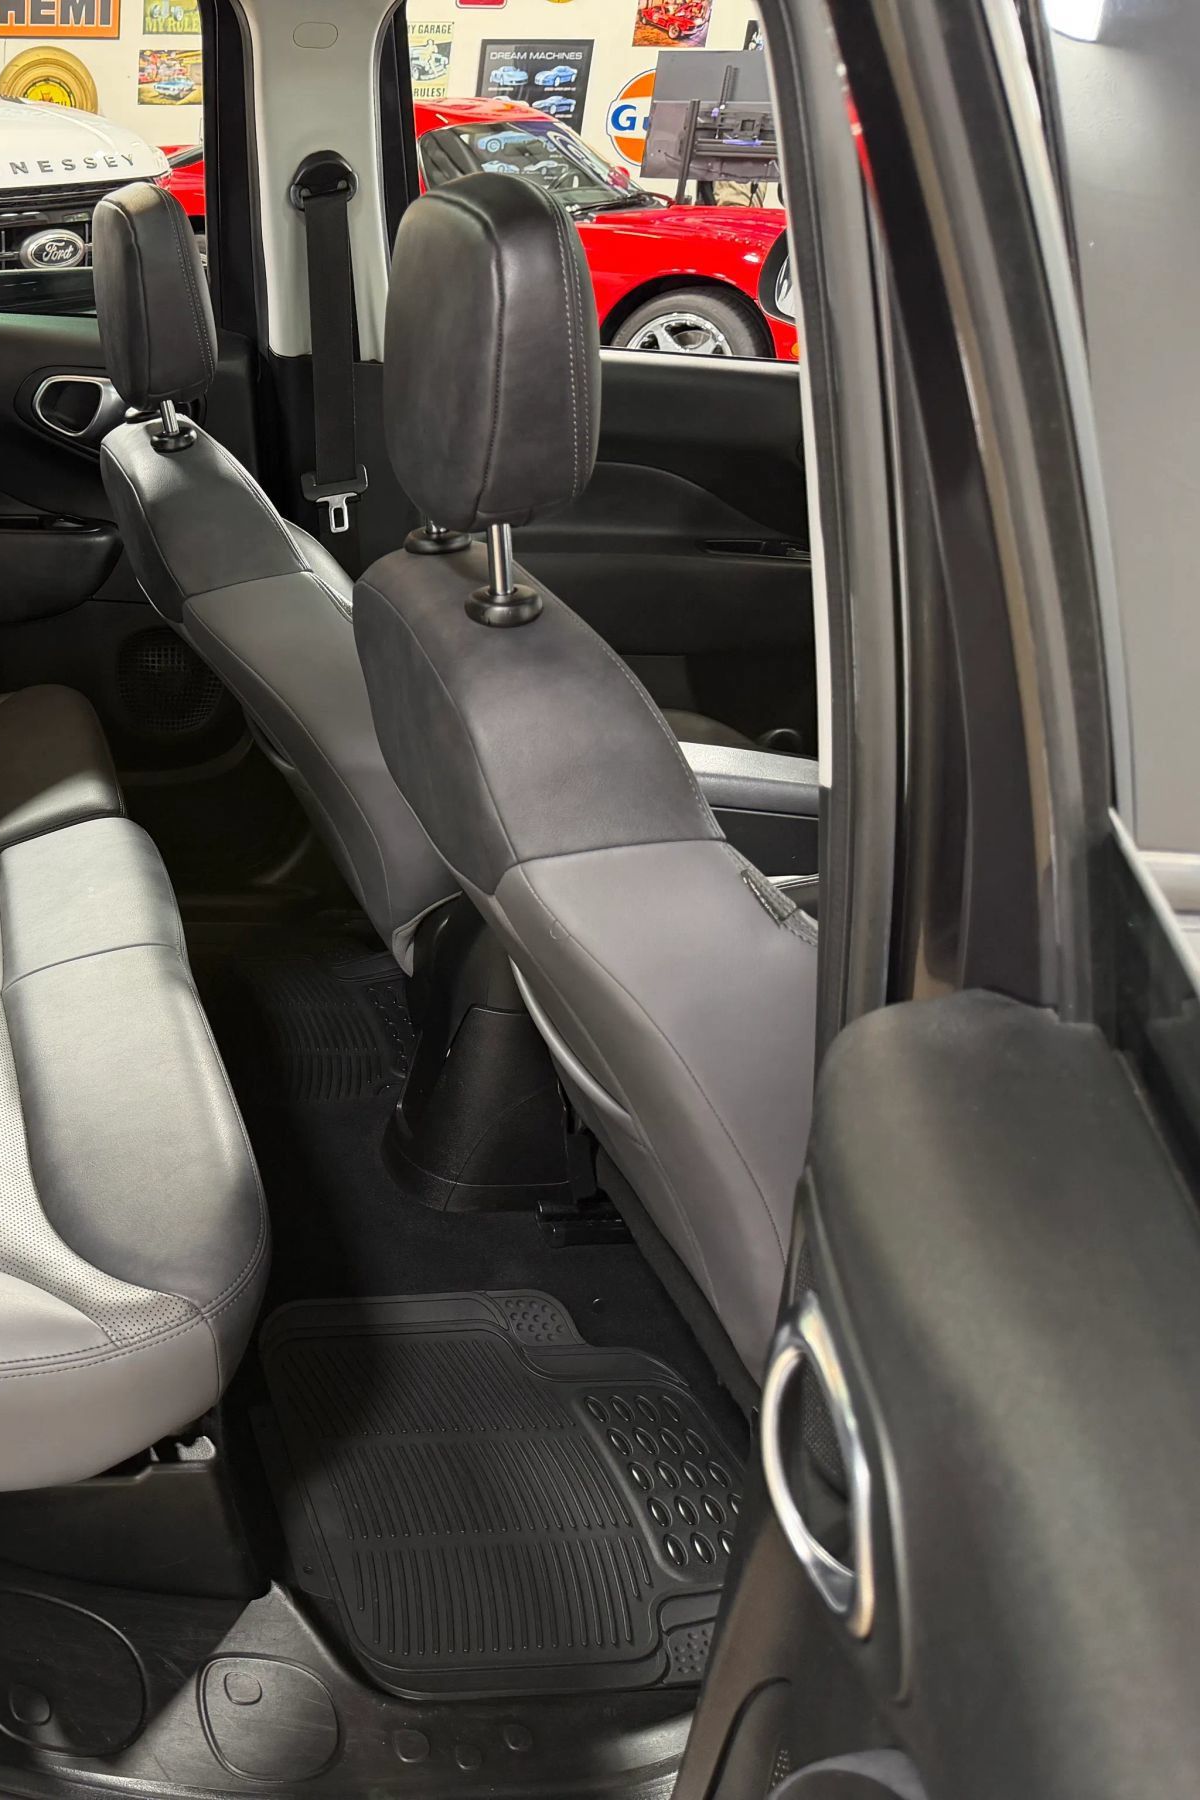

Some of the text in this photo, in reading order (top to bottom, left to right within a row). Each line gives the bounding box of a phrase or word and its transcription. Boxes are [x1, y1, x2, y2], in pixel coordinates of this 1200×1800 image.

[418, 24, 452, 34] GARAGE
[490, 52, 583, 60] DREAM MACHINES
[413, 88, 446, 97] RULES!
[42, 241, 74, 261] Ford
